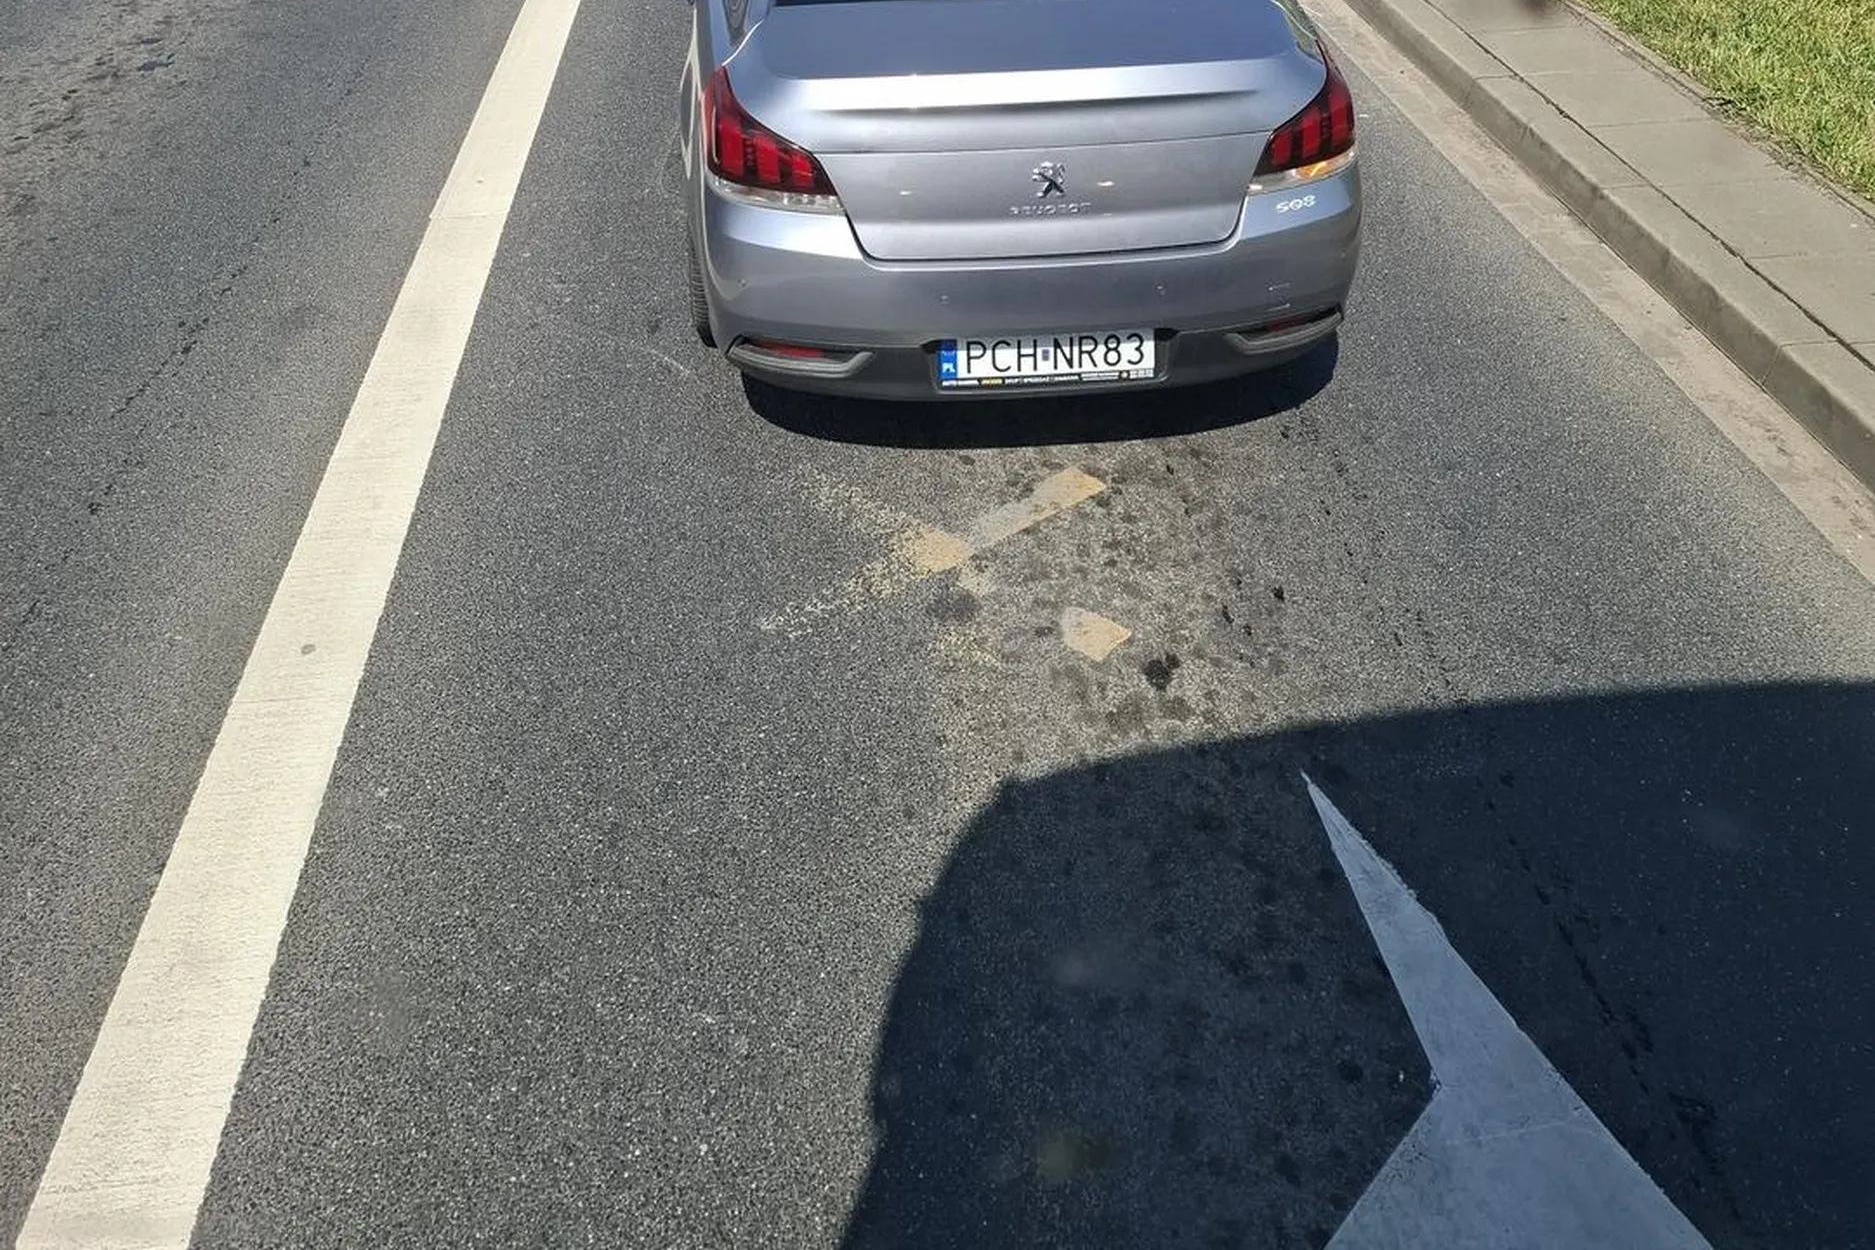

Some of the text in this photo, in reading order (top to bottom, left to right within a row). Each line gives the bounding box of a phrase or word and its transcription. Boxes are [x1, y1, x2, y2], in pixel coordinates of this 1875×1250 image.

[1276, 194, 1317, 214] 508
[965, 332, 1145, 374] PCH NR83
